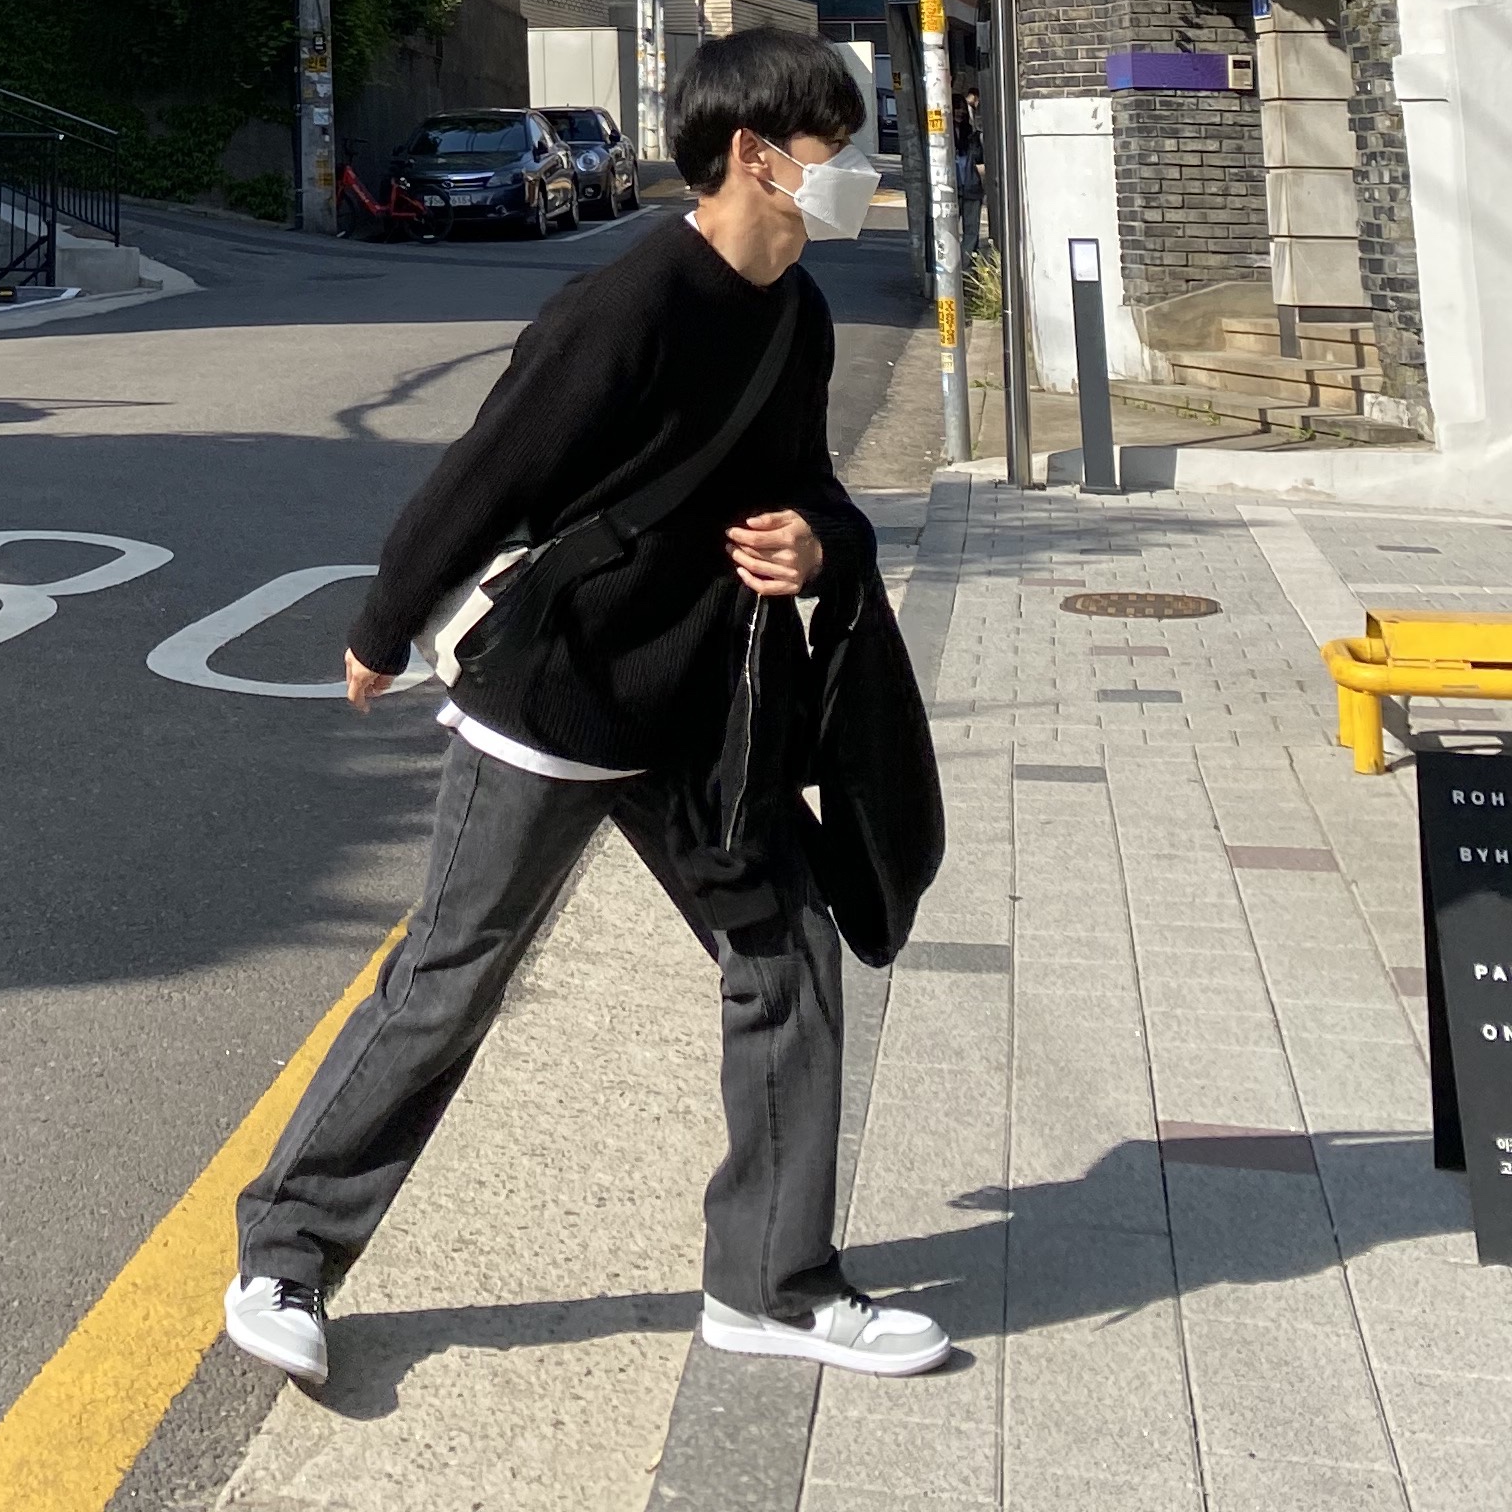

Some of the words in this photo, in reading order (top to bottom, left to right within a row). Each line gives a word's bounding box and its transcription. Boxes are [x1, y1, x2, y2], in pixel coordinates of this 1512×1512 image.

[1452, 789, 1505, 807] ROH
[1459, 846, 1510, 864] BYH
[1473, 961, 1512, 982] PA
